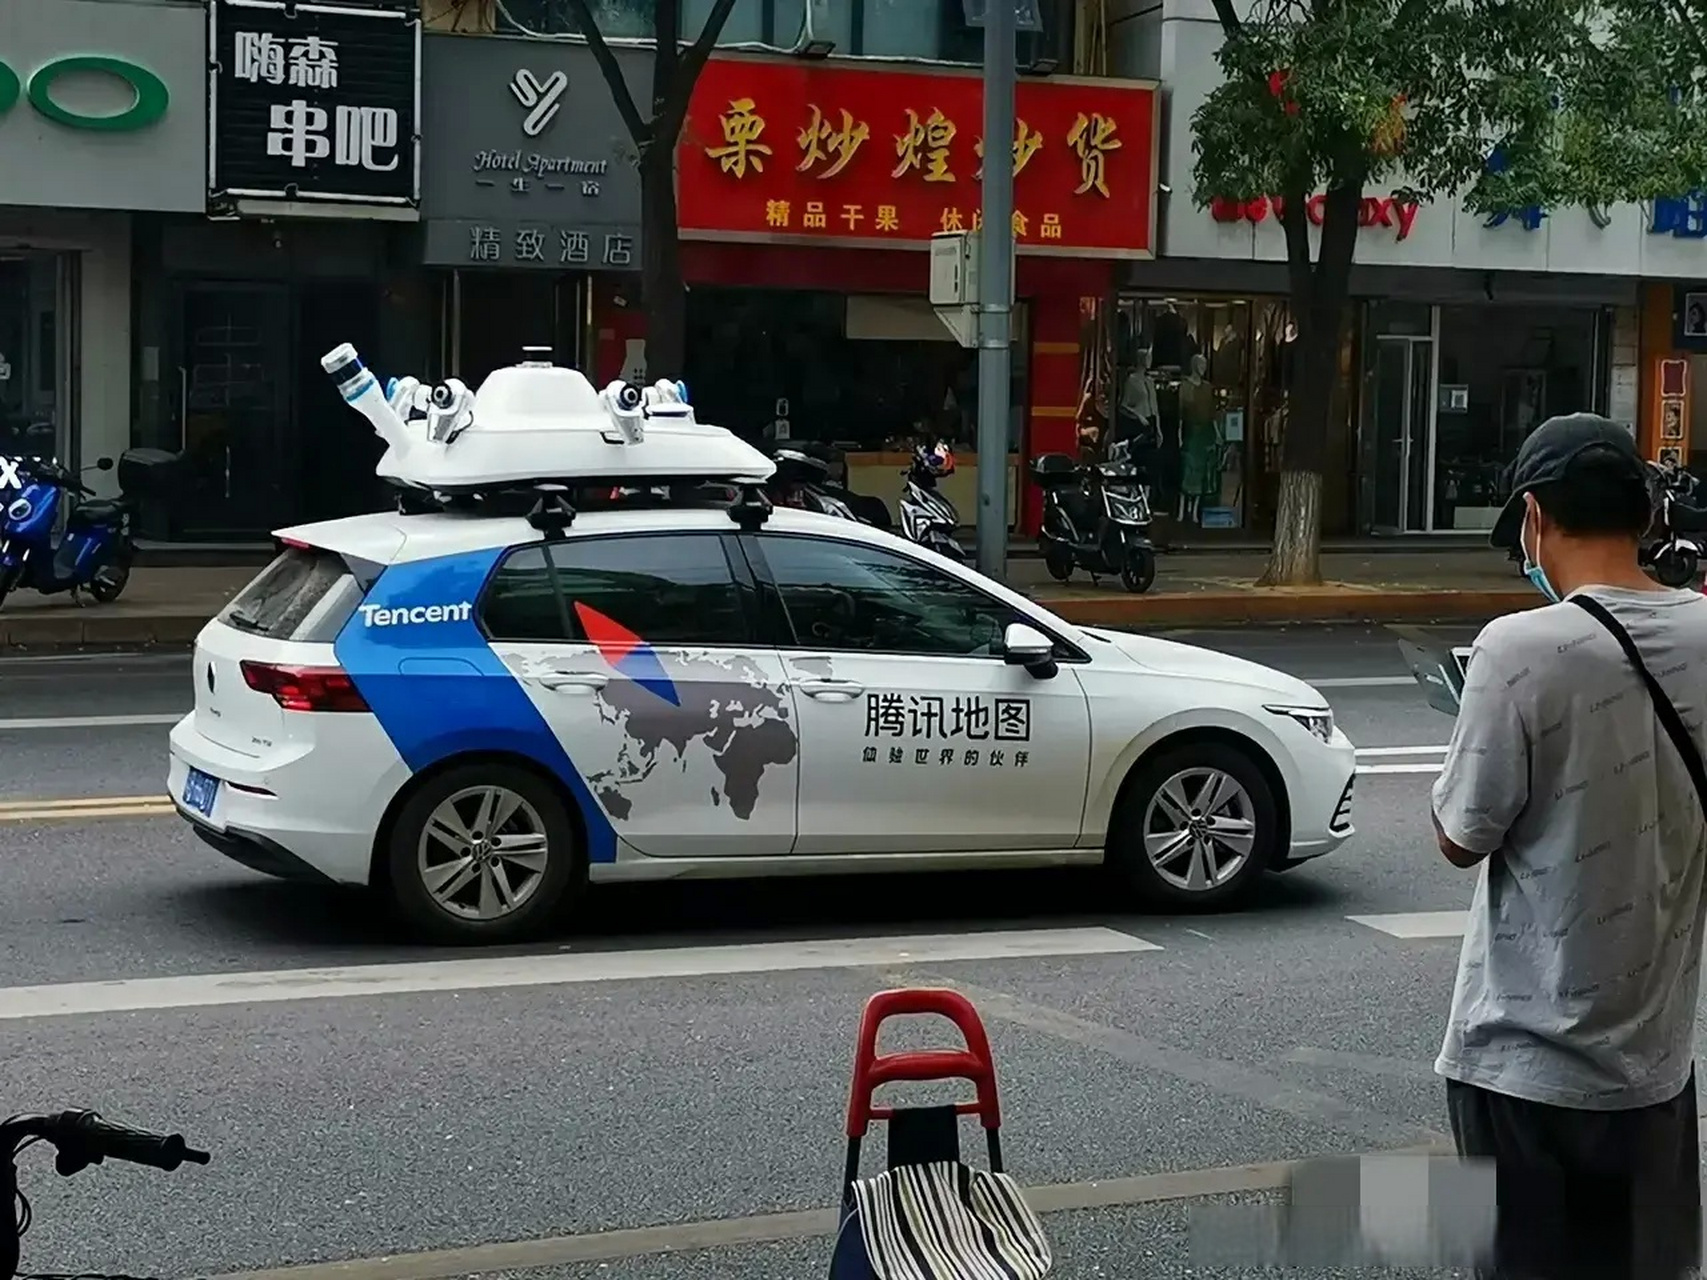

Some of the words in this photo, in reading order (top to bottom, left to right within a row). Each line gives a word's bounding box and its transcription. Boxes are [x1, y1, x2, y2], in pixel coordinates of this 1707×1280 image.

[234, 31, 338, 89] 嗨森
[267, 99, 399, 171] 串吧
[473, 149, 521, 171] Hotel
[522, 153, 607, 177] Apartment
[765, 199, 899, 231] 精品干果
[469, 226, 633, 265] 精致酒店
[359, 600, 472, 627] Tencent
[865, 693, 1030, 742] 腾讯地图
